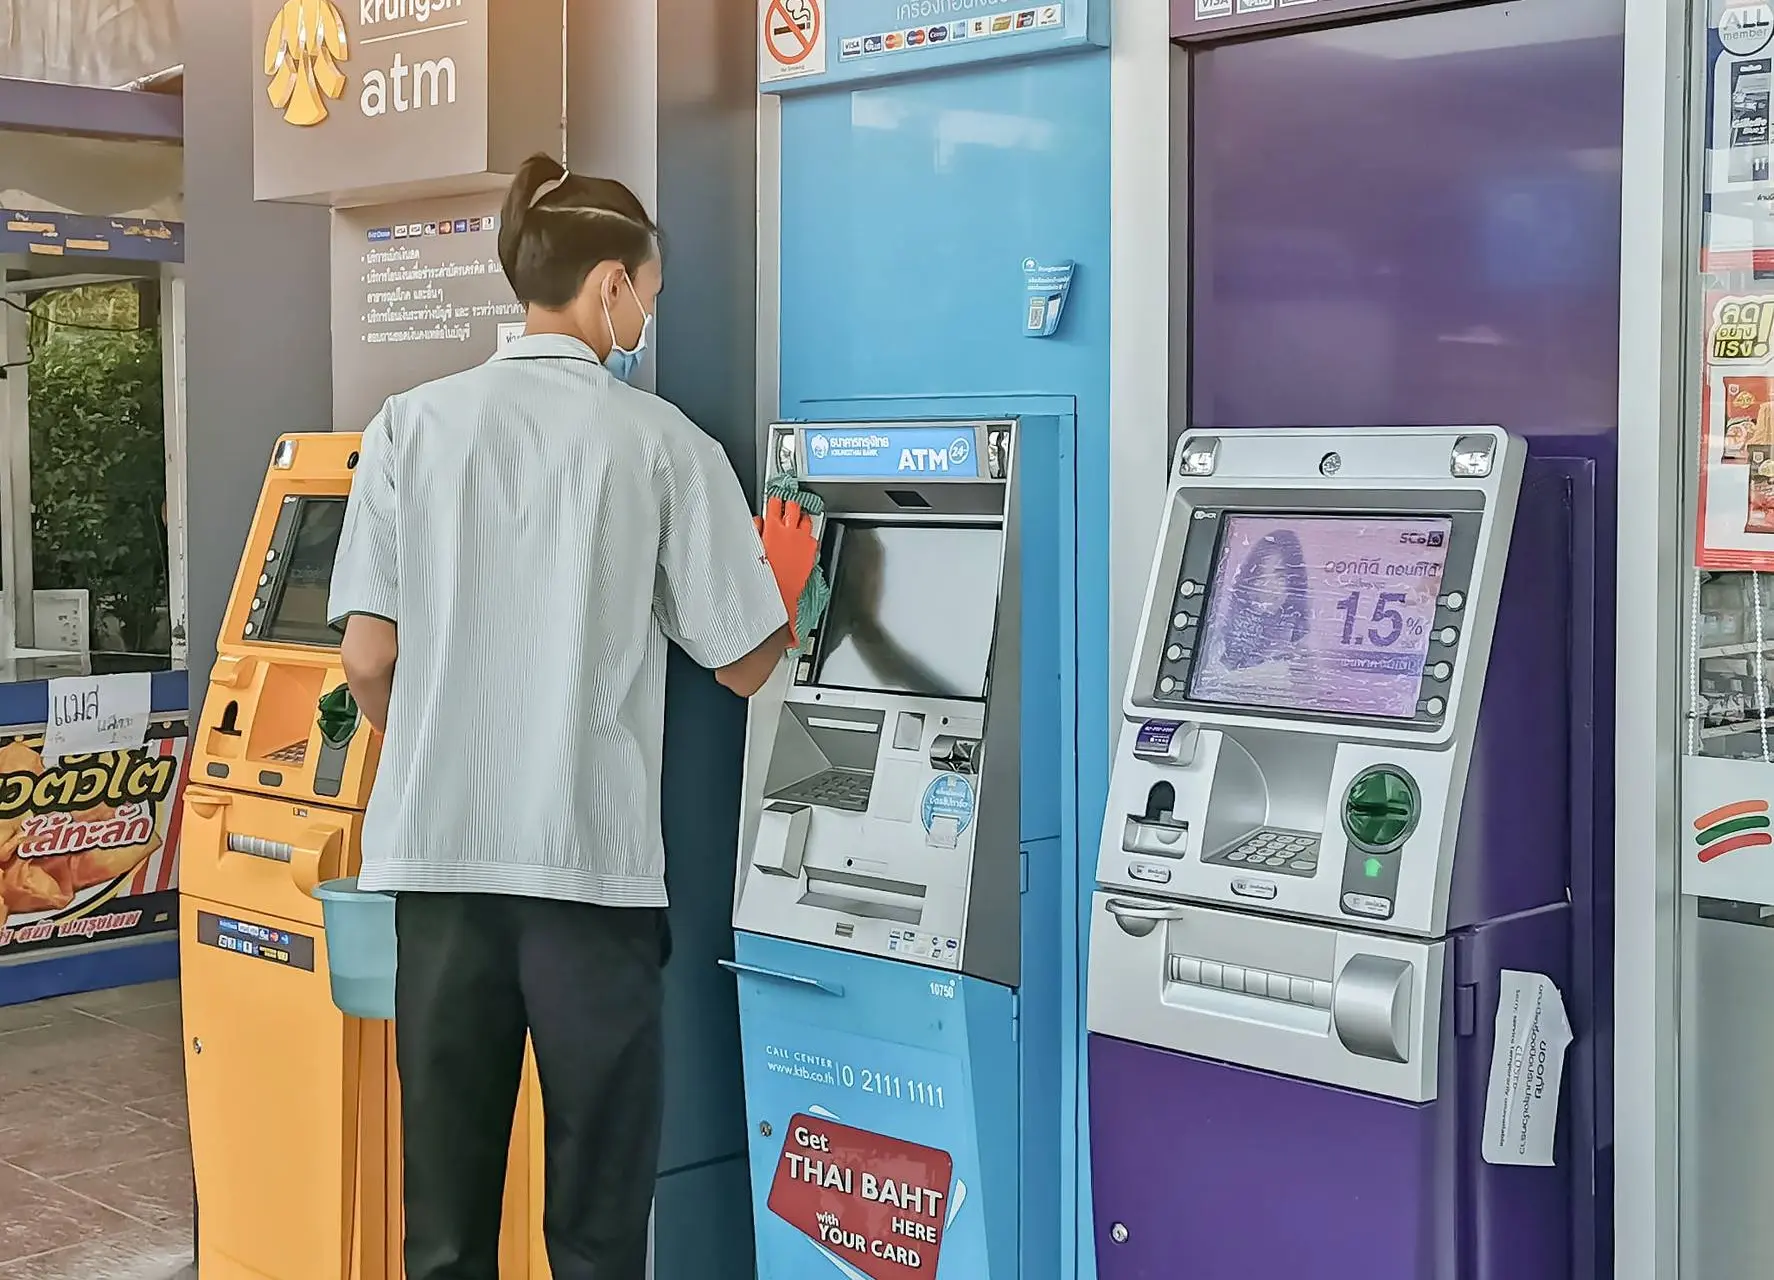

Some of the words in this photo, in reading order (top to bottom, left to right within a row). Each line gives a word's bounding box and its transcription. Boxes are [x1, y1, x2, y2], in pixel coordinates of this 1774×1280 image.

[1724, 9, 1769, 30] ALL
[1723, 28, 1767, 40] member
[360, 53, 456, 117] atm
[898, 448, 948, 471] ATM
[766, 1045, 789, 1060] CALL
[794, 1051, 834, 1068] CENTER
[862, 1070, 901, 1099] 2111
[908, 1079, 944, 1108] 1111
[767, 1062, 834, 1085] www.ktb.co.th
[1534, 1040, 1547, 1100] ขออภัย
[794, 1126, 830, 1152] Get
[785, 1152, 853, 1194] THAI
[861, 1173, 943, 1217] BAHT
[816, 1211, 839, 1227] with
[892, 1216, 937, 1243] HERE
[818, 1225, 867, 1253] YOUR
[871, 1240, 921, 1268] CARD
